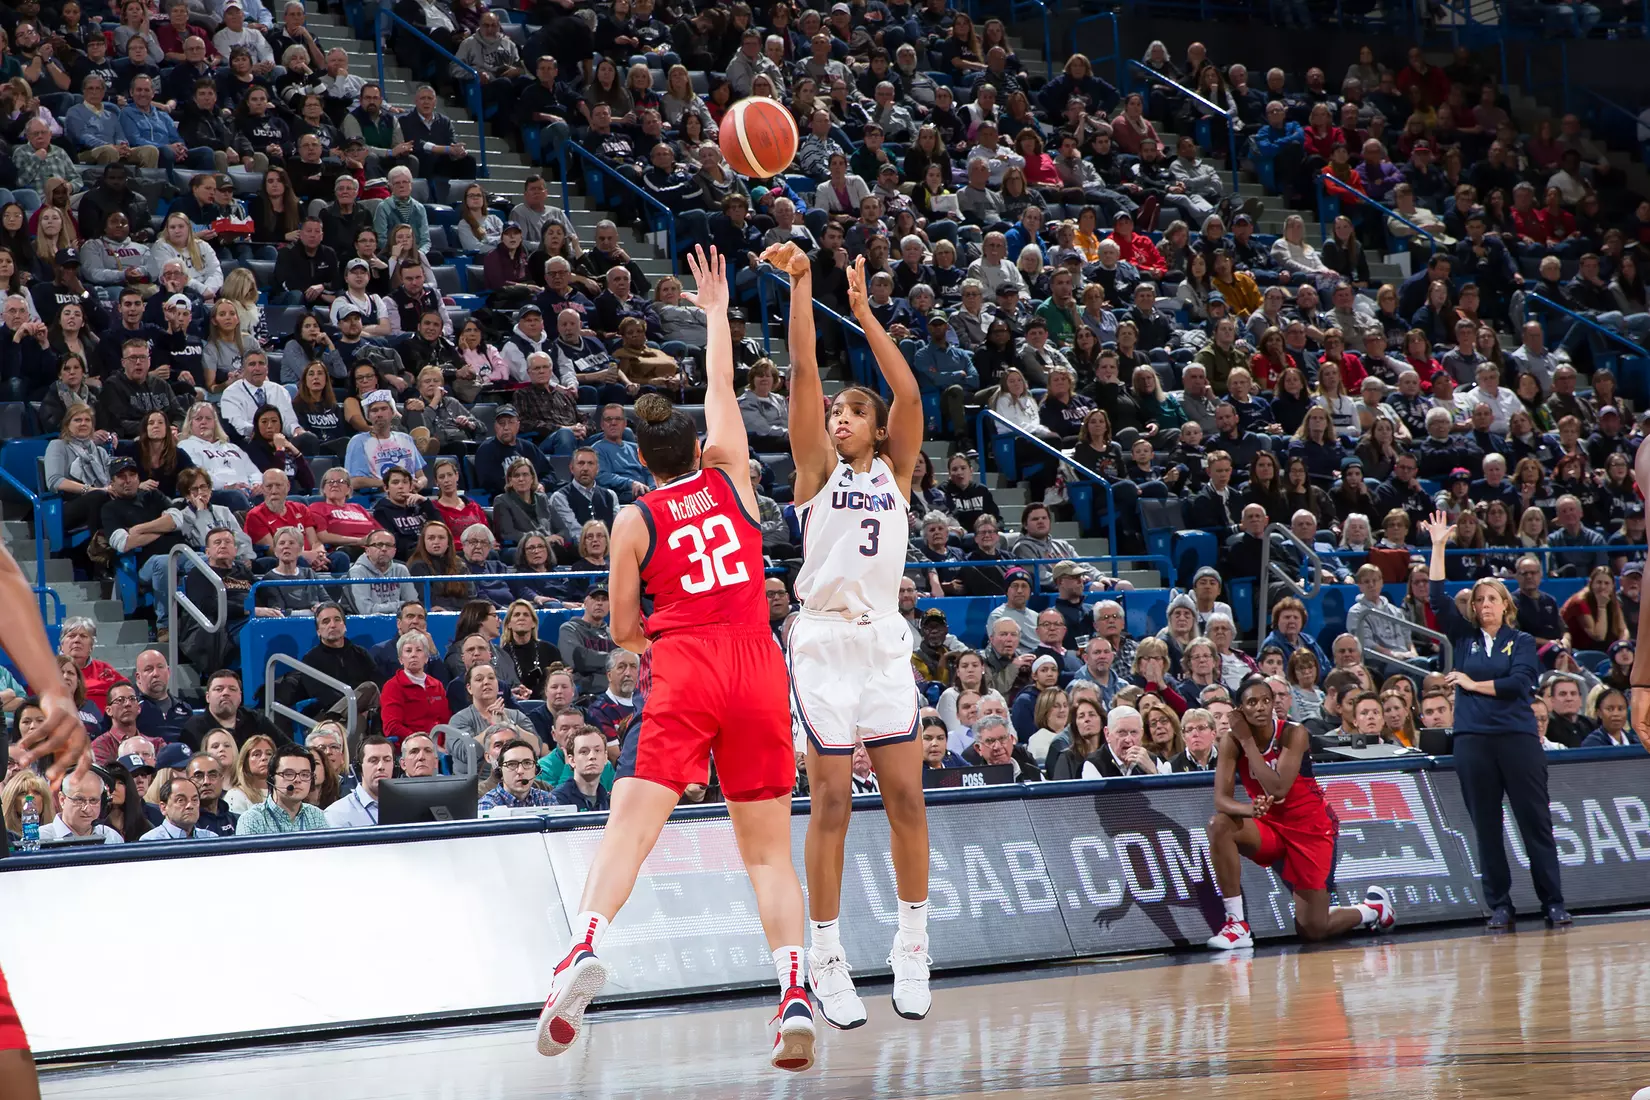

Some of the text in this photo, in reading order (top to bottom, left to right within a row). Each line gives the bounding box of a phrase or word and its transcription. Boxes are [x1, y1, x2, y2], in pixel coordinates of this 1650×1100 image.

[307, 414, 339, 426] UCONN
[667, 486, 718, 522] McBRIDE
[832, 491, 897, 512] UCONN
[859, 518, 881, 557] 3
[668, 513, 750, 594] 32
[961, 772, 987, 787] POSS.
